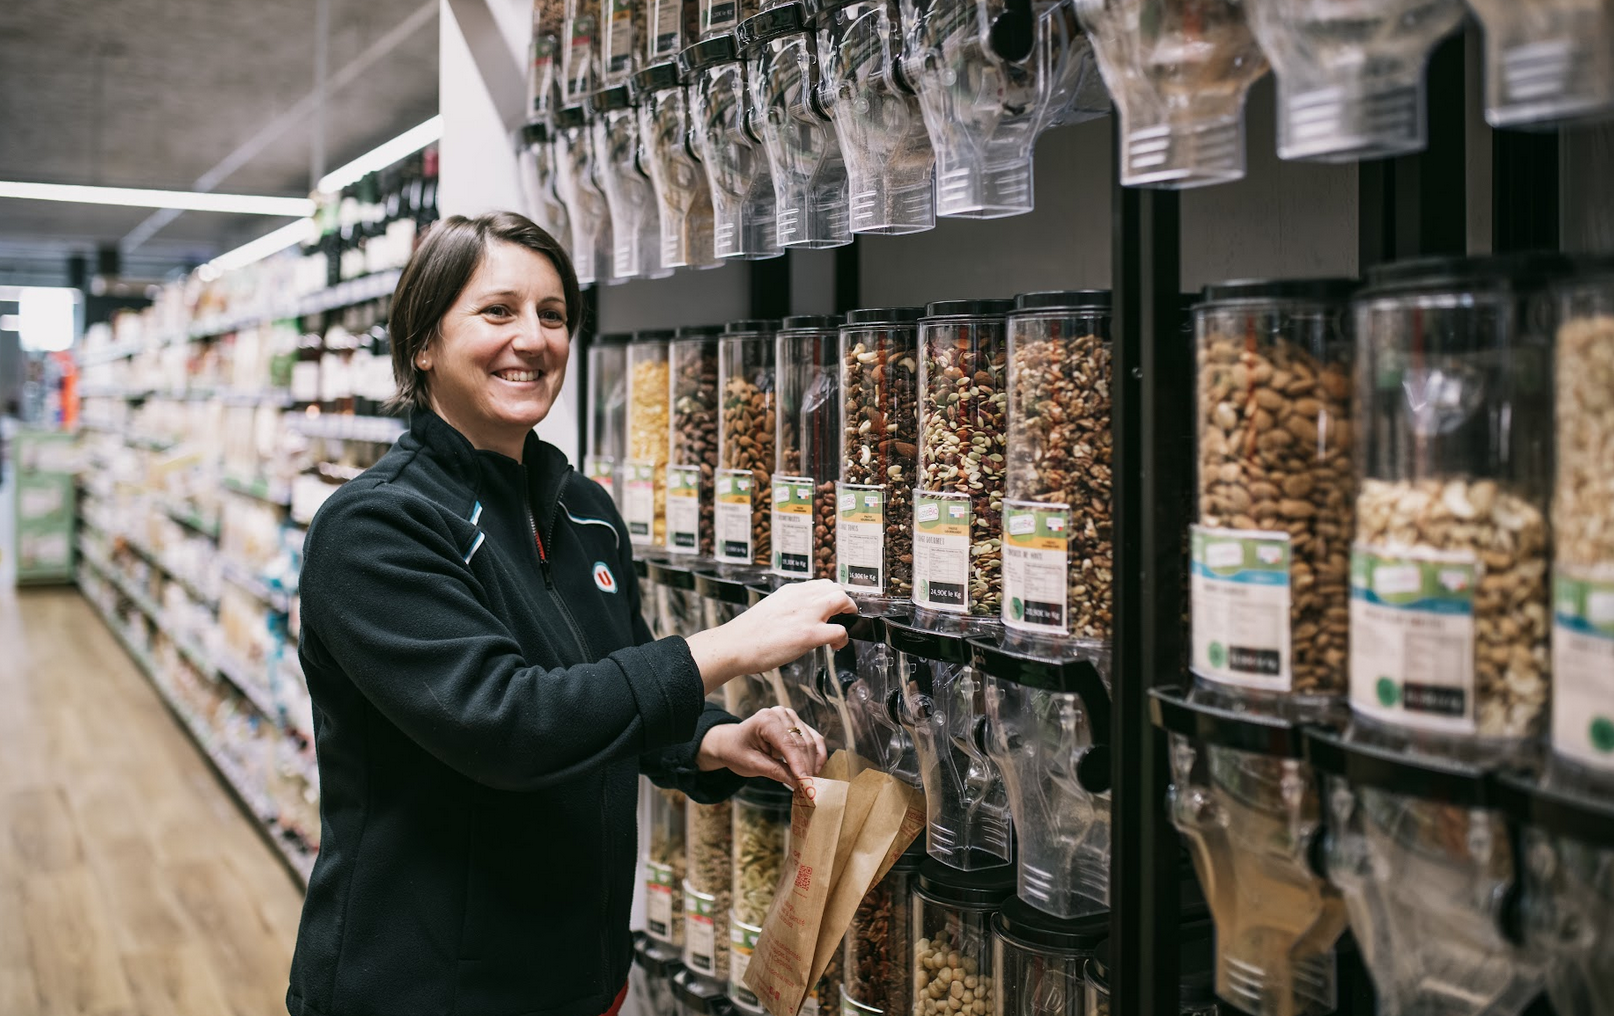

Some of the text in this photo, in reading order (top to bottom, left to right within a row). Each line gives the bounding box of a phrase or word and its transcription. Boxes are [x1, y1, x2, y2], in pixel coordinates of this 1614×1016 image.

[597, 571, 612, 586] U
[930, 588, 947, 596] 24,90€
[954, 591, 962, 599] Kg
